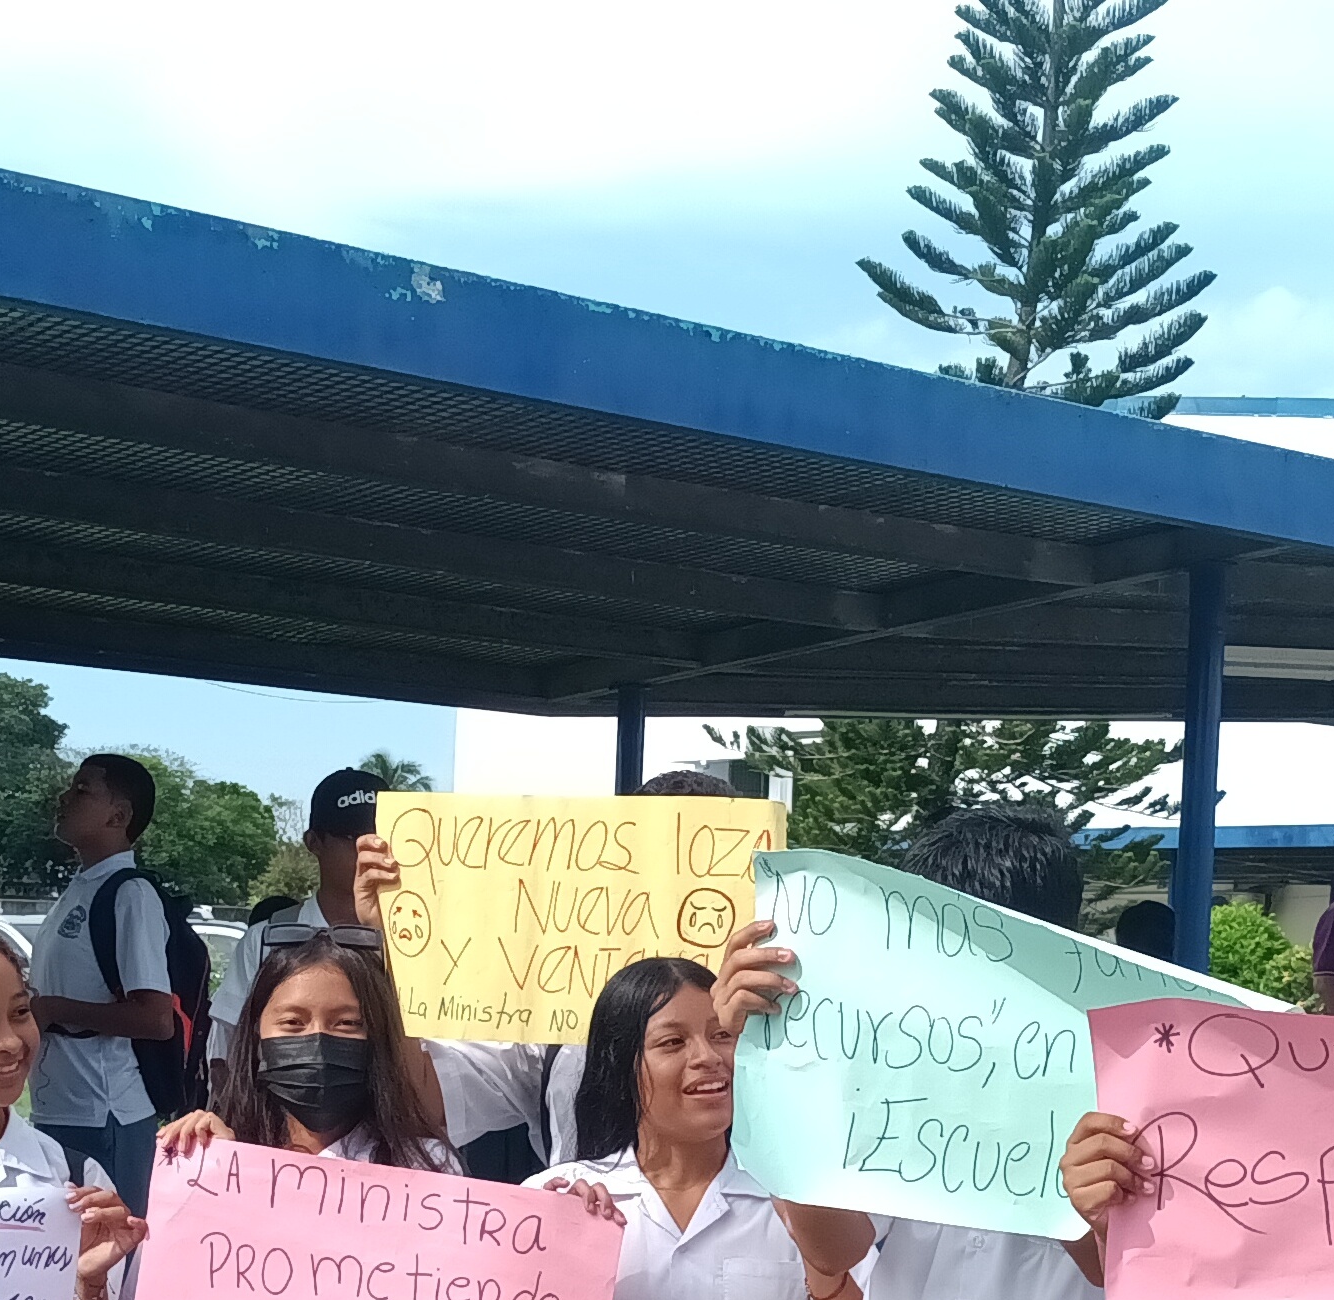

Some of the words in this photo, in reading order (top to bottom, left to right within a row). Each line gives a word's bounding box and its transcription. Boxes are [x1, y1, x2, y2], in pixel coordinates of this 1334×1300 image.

[337, 790, 376, 808] adid
[389, 808, 639, 895] Queremos
[515, 877, 660, 940] Nueva
[437, 991, 533, 1030] Ministra
[1014, 1020, 1077, 1080] en
